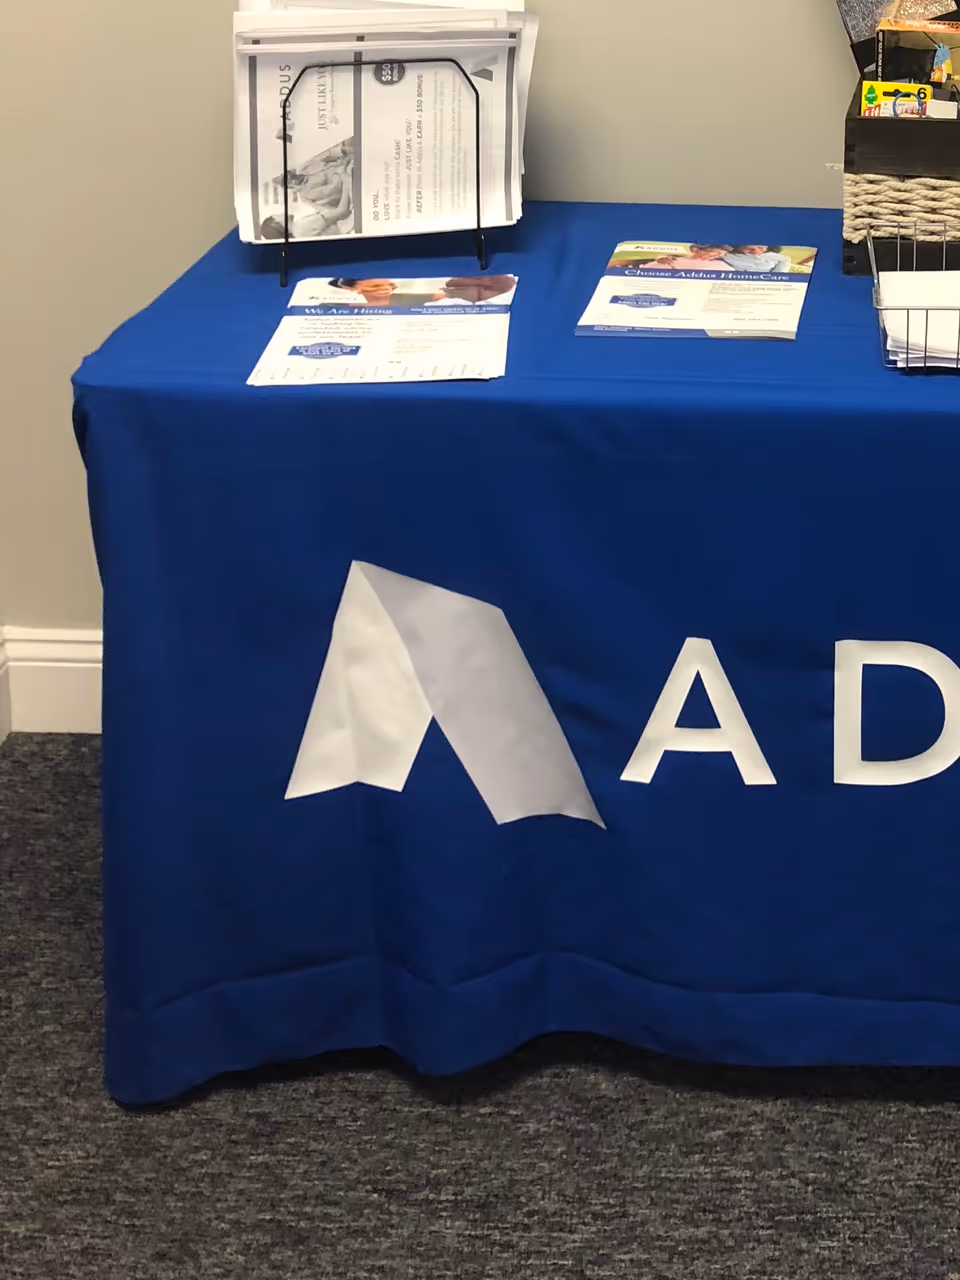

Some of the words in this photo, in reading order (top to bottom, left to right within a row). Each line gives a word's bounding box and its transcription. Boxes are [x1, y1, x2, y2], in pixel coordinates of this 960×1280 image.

[278, 64, 292, 121] ADDUS
[917, 87, 928, 100] 6
[372, 210, 380, 221] DO
[624, 268, 672, 278] Choose
[674, 270, 717, 279] Addus
[720, 272, 790, 281] HomeCare
[330, 307, 350, 315] Are
